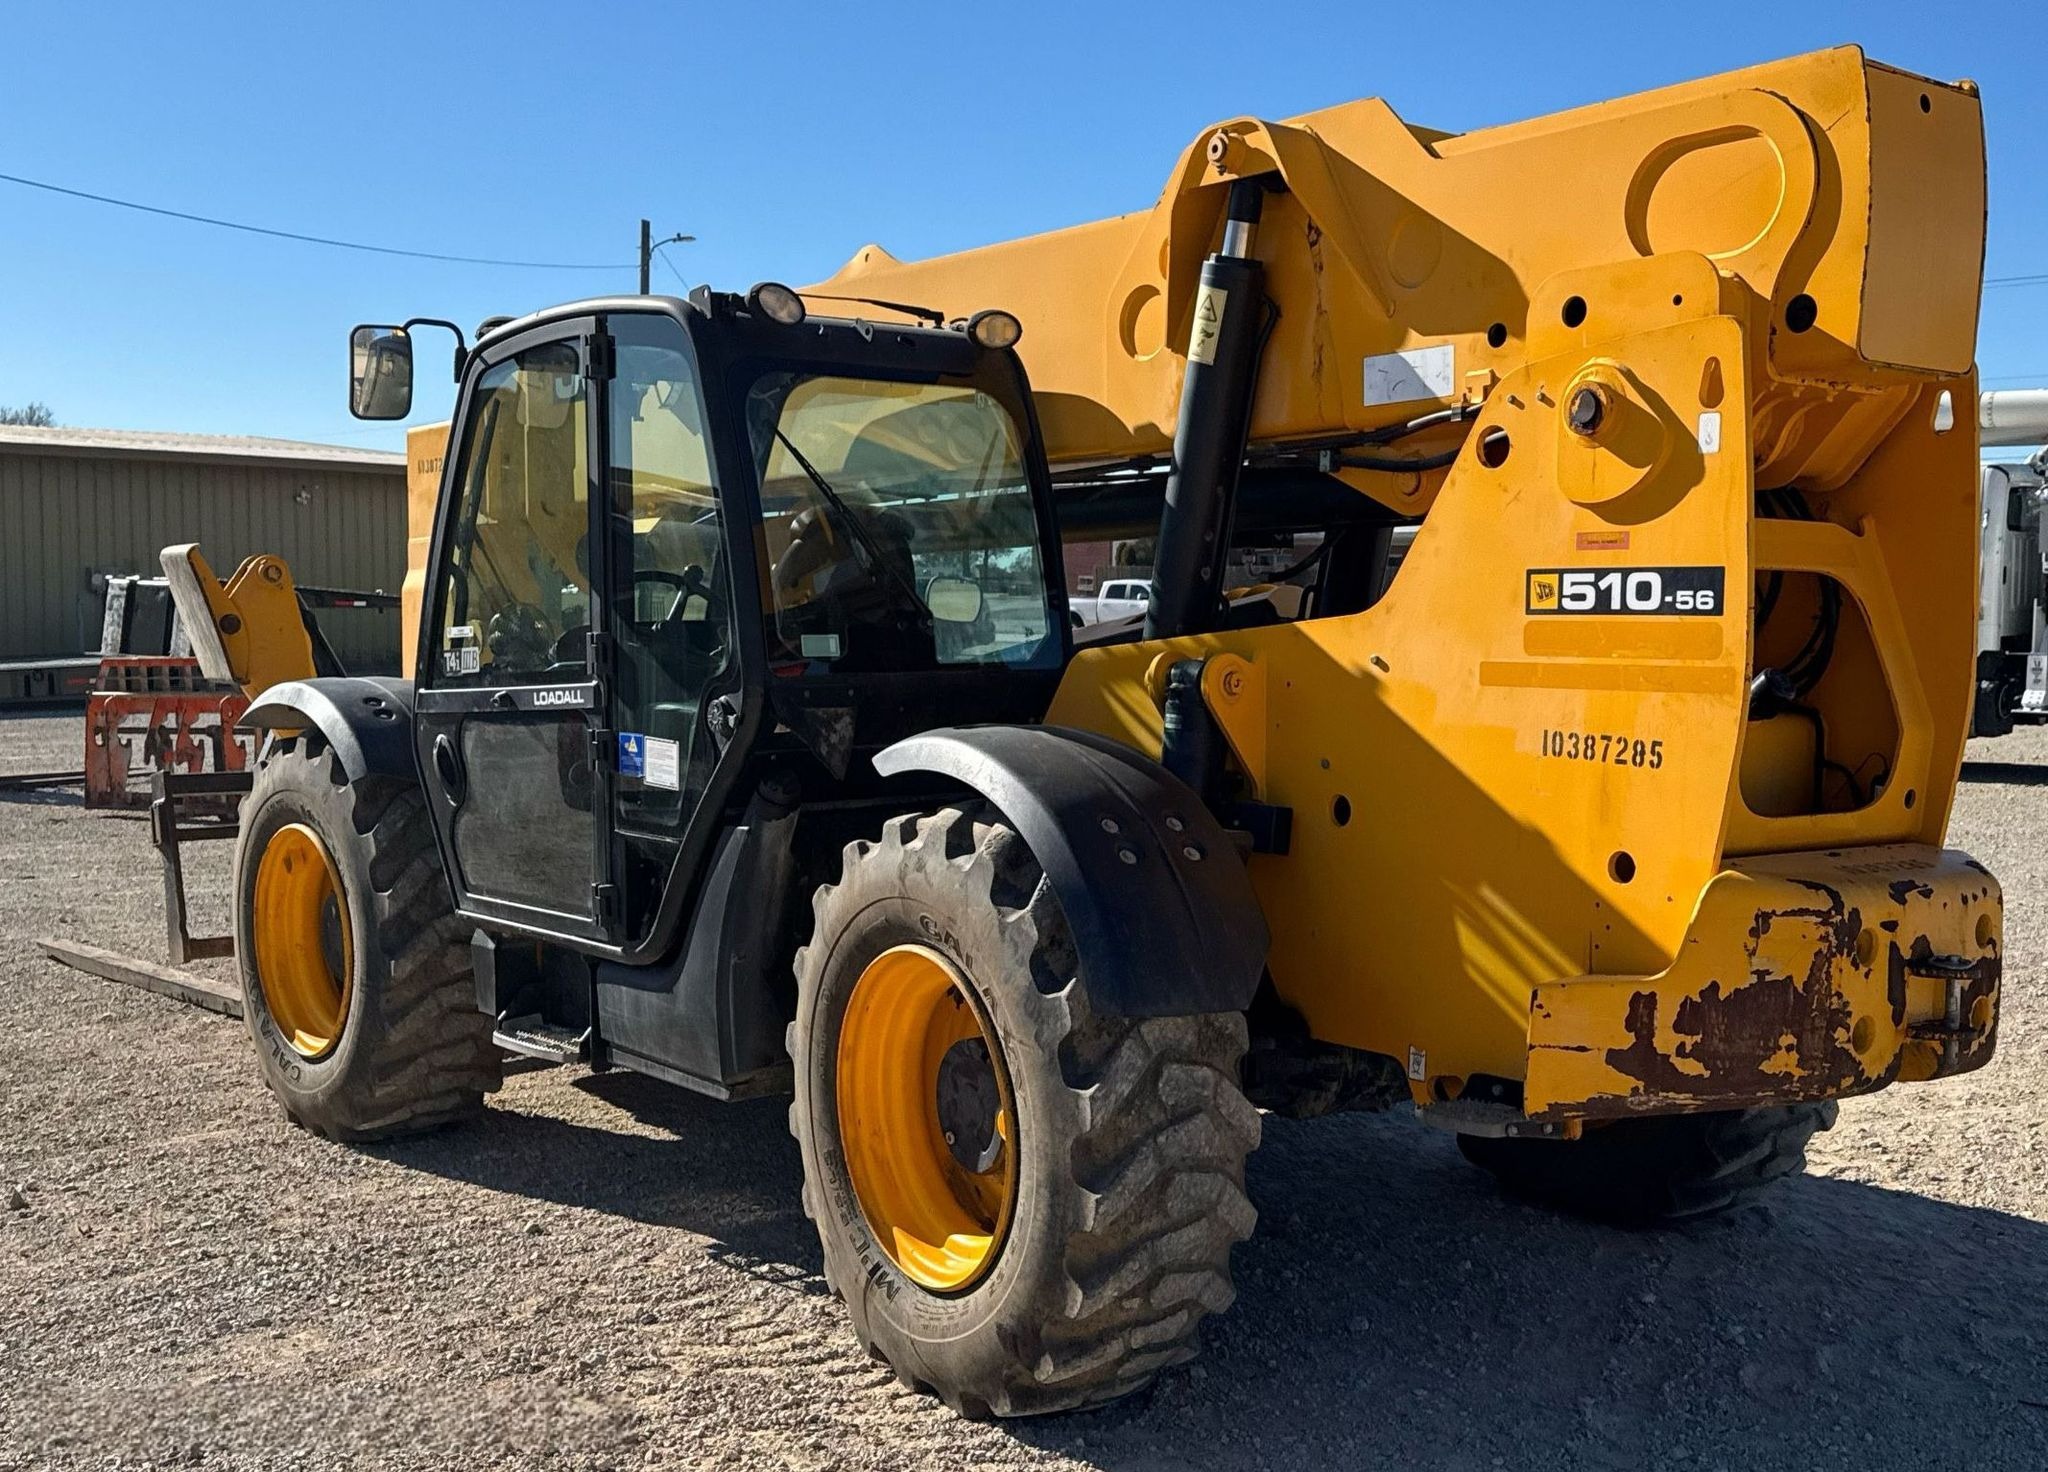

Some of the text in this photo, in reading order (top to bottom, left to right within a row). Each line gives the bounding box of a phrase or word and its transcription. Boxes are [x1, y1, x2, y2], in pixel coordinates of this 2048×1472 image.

[1561, 571, 1715, 611] 510-56
[533, 689, 585, 706] LOADALL
[1542, 729, 1664, 770] 10387285
